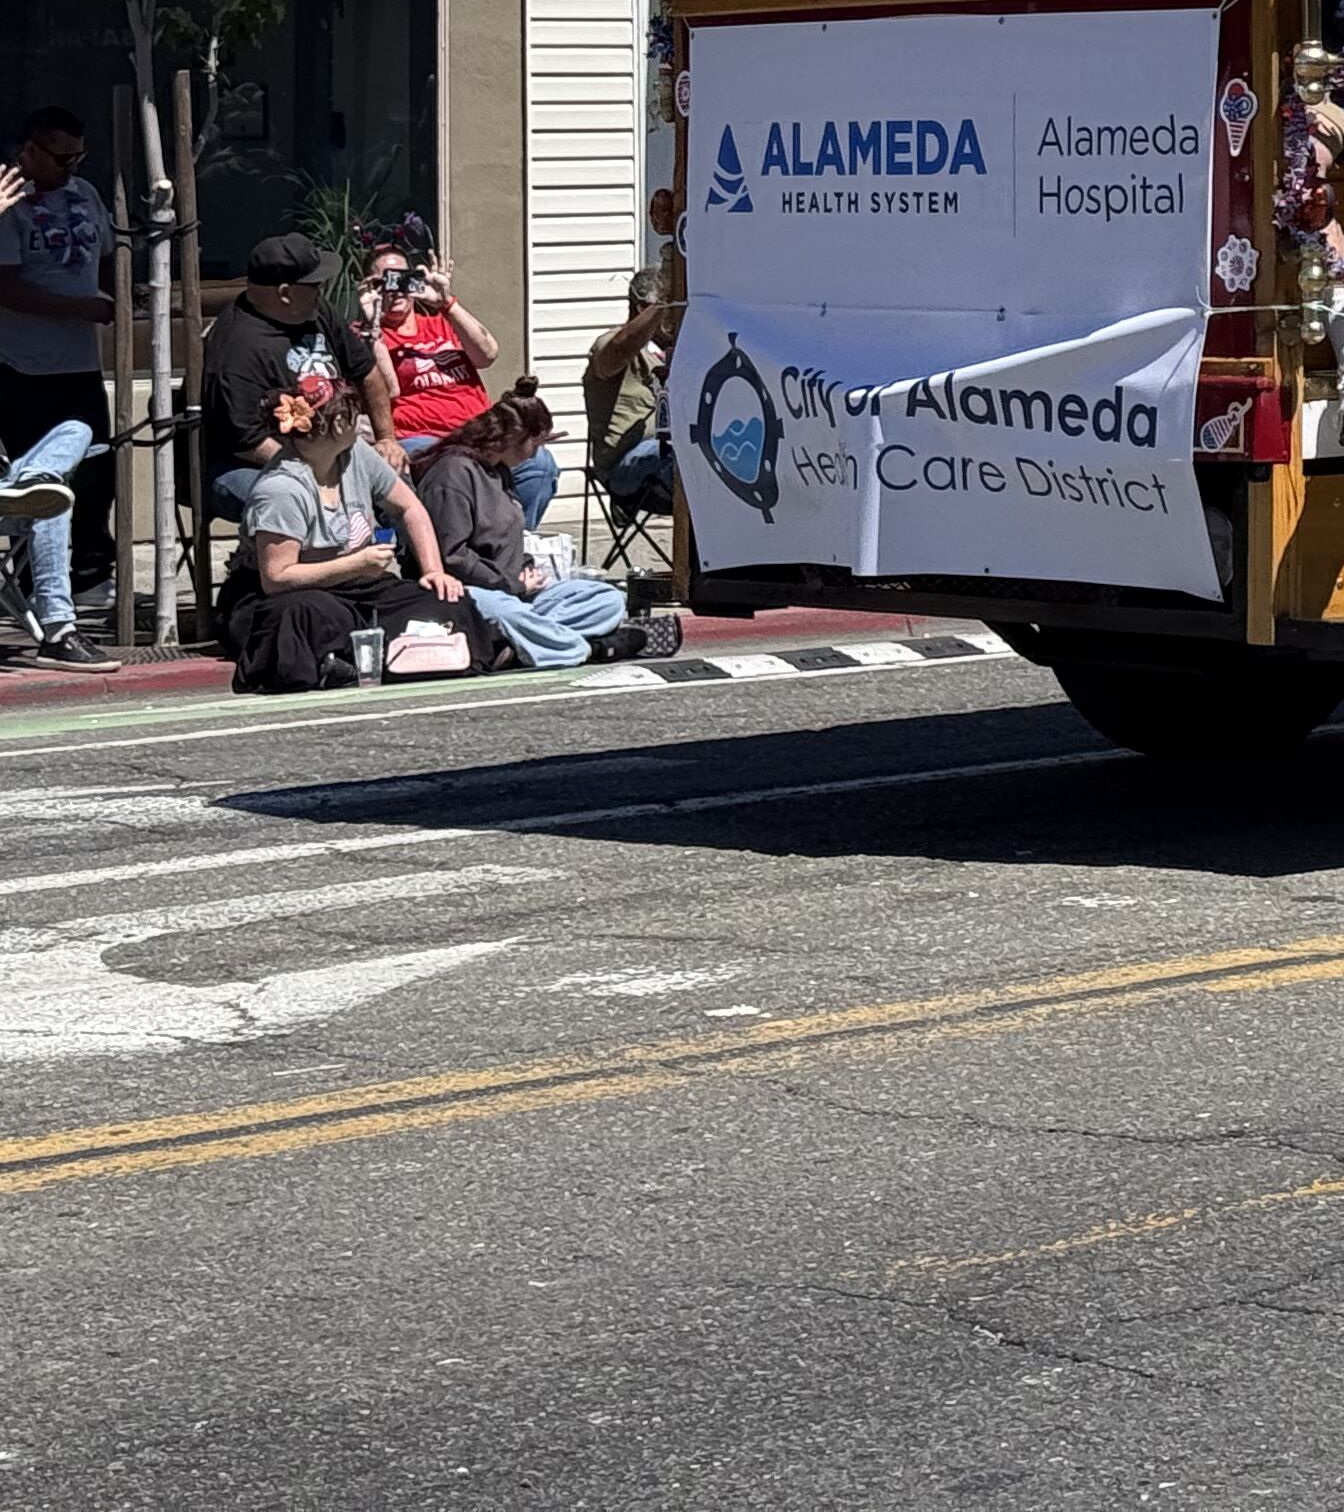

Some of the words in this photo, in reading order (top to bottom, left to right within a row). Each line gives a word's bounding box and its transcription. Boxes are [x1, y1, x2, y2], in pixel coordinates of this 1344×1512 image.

[761, 118, 988, 177] ALAMEDA
[1037, 114, 1200, 157] Alameda
[781, 191, 860, 215] HEALTH
[870, 190, 959, 215] SYSTEM
[1038, 173, 1185, 222] Hospital
[781, 366, 844, 428] City
[905, 372, 1158, 448] Alameda
[876, 444, 1006, 492] Care
[1017, 456, 1168, 514] District
